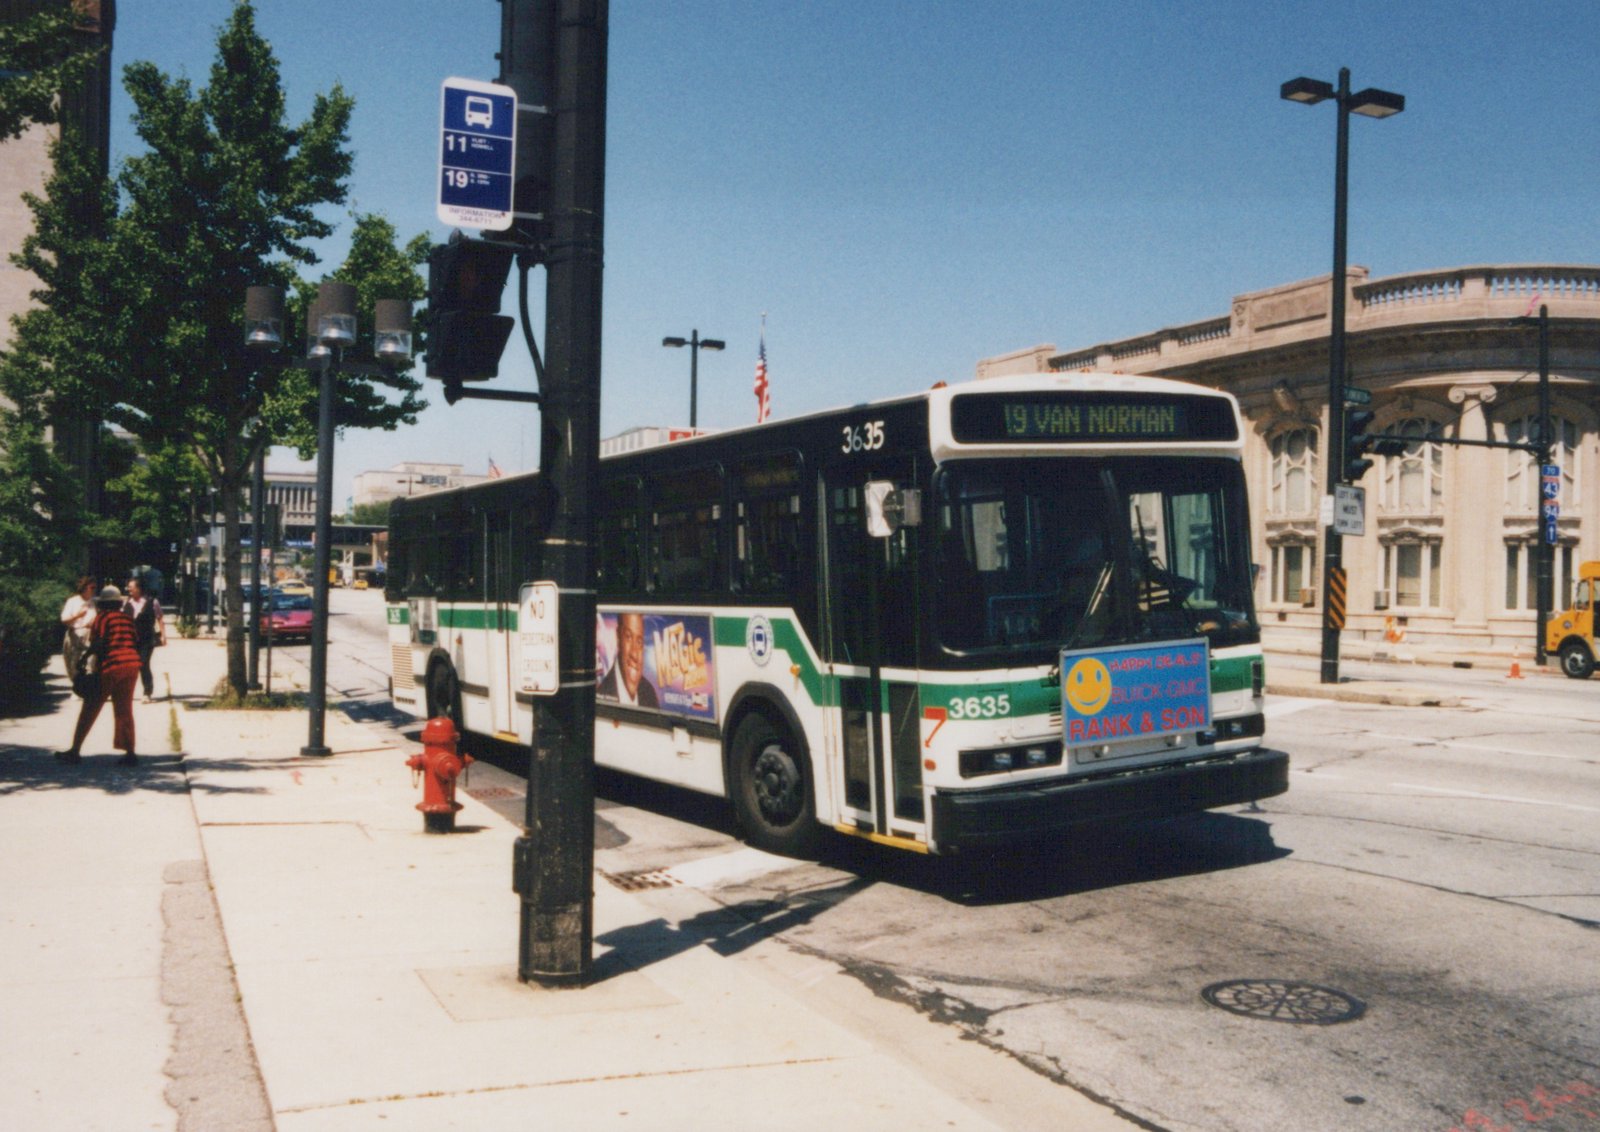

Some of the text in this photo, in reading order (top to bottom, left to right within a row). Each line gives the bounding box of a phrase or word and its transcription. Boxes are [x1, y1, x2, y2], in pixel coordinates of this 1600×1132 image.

[445, 134, 467, 152] 11
[445, 170, 468, 188] 19
[1034, 405, 1081, 433] VAN
[1088, 405, 1175, 433] NORMAN
[842, 421, 885, 454] 3635
[1544, 481, 1558, 494] 43
[1544, 505, 1558, 518] 94
[530, 600, 544, 620] NO
[1110, 657, 1153, 673] HAPPY
[949, 694, 1010, 719] 3635
[1069, 704, 1205, 741] RANK & SON
